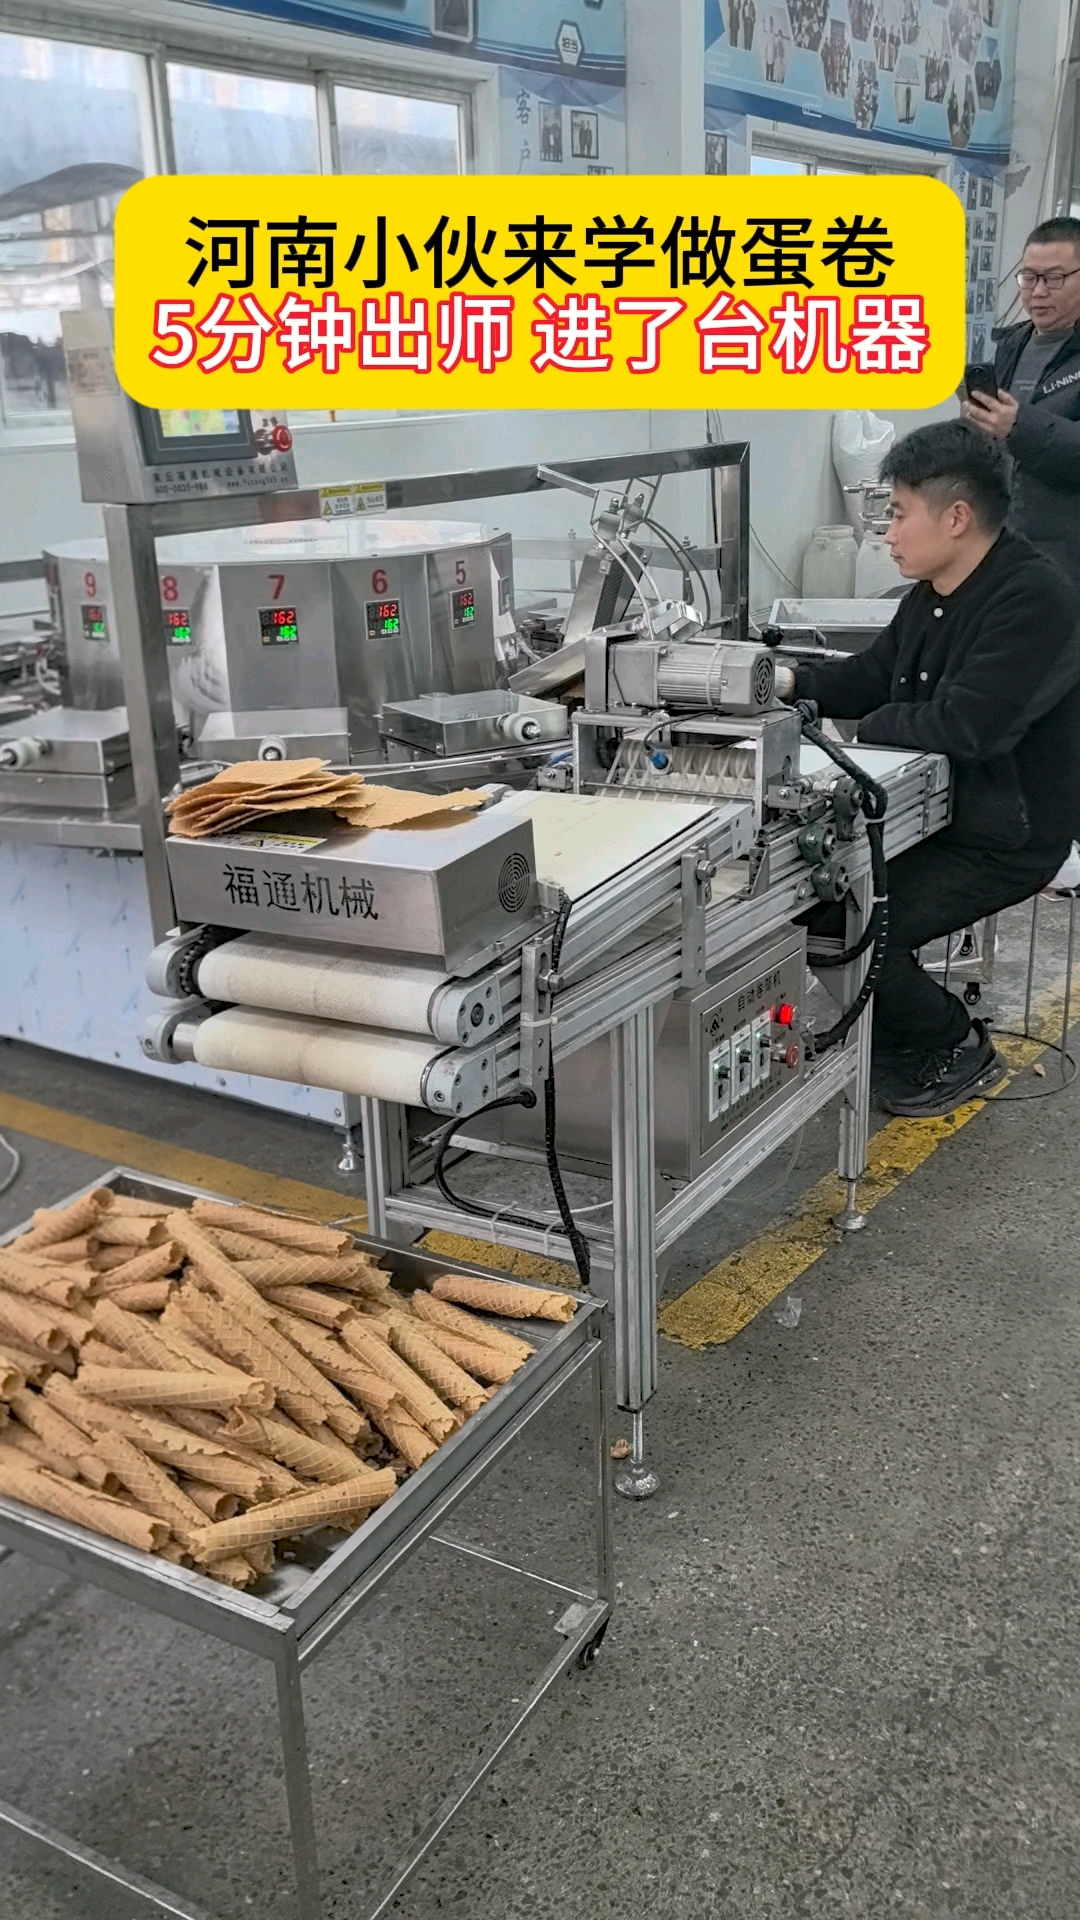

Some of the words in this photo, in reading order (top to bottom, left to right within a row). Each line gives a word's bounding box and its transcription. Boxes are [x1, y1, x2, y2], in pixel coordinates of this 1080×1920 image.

[84, 572, 97, 598] 9
[371, 568, 389, 594] 6
[455, 560, 467, 585] 5
[162, 576, 178, 602] 8
[268, 574, 285, 600] 7
[460, 592, 473, 606] 162
[273, 610, 295, 624] 162
[378, 603, 397, 617] 162
[384, 618, 399, 630] 162
[222, 863, 379, 921] 福通机械
